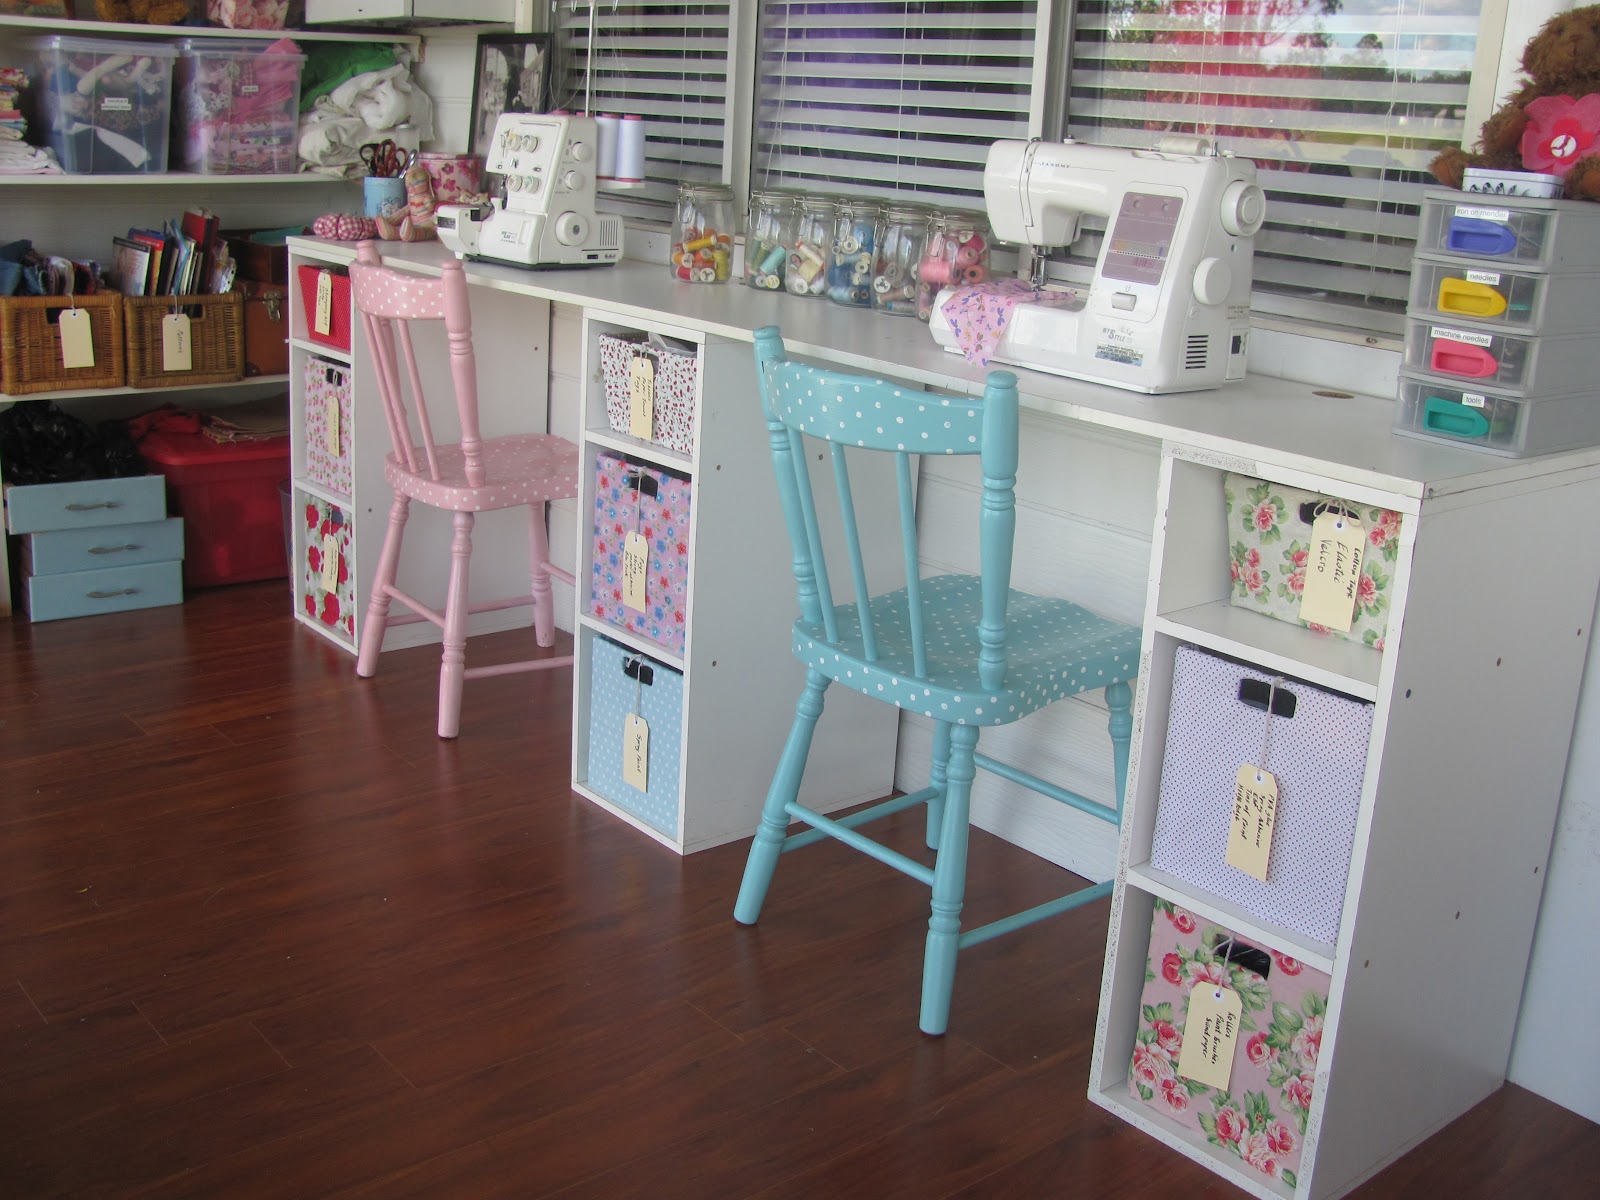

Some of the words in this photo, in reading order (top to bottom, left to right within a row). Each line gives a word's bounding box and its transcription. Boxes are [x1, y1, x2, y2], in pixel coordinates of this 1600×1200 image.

[1469, 273, 1498, 284] needles
[1434, 328, 1462, 341] machine
[1462, 334, 1490, 345] needles
[1465, 395, 1482, 405] tools
[1318, 539, 1333, 573] Velcro
[1333, 540, 1349, 584] Elastic
[1266, 793, 1275, 811] PVA
[1225, 1012, 1237, 1039] Rollers
